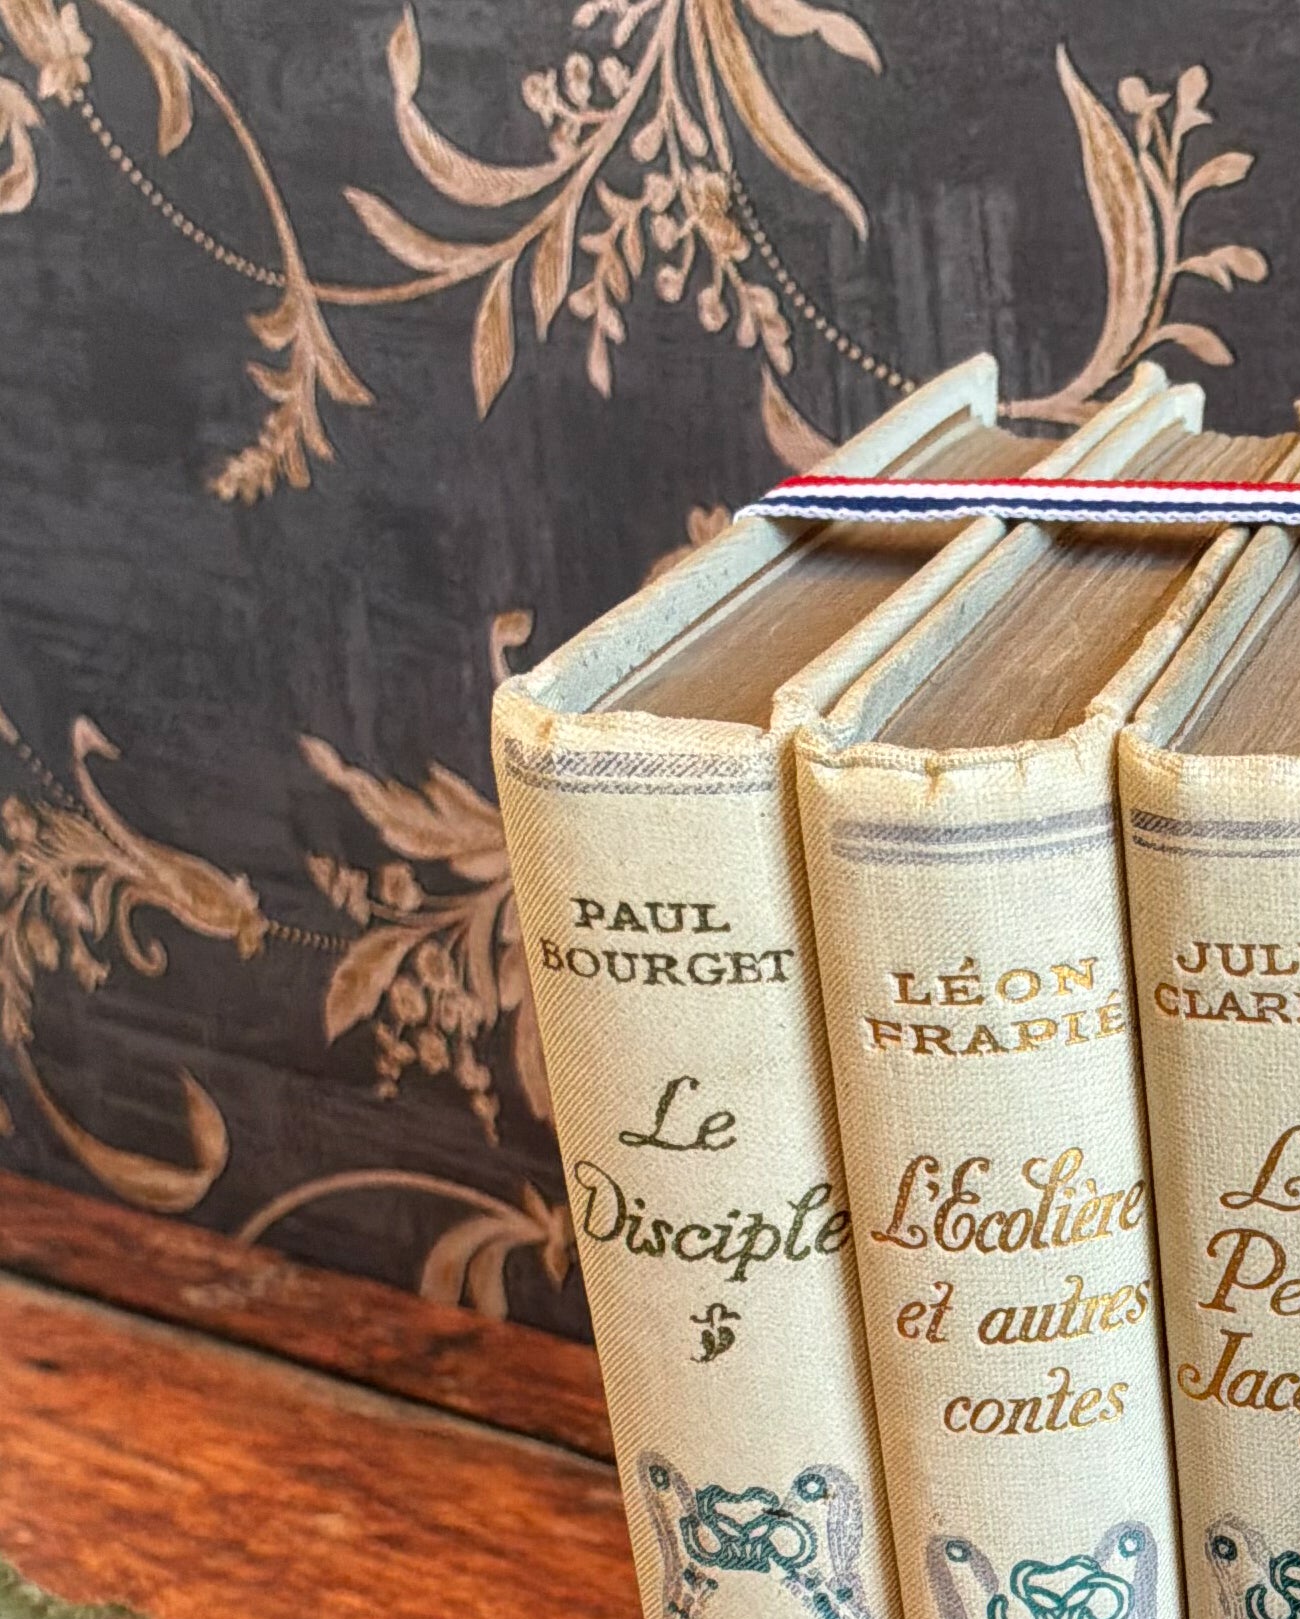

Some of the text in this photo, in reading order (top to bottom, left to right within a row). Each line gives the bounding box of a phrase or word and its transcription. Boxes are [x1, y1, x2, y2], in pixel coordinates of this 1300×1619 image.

[571, 898, 730, 934] PAUL
[540, 939, 794, 986] BOURGET
[892, 957, 1100, 1006] LÉON
[864, 990, 1127, 1057] FRAPIÉ
[618, 1075, 736, 1151] Le
[574, 1160, 852, 1282] Disciple
[896, 1275, 1153, 1345] et autres
[943, 1367, 1129, 1435] contes
